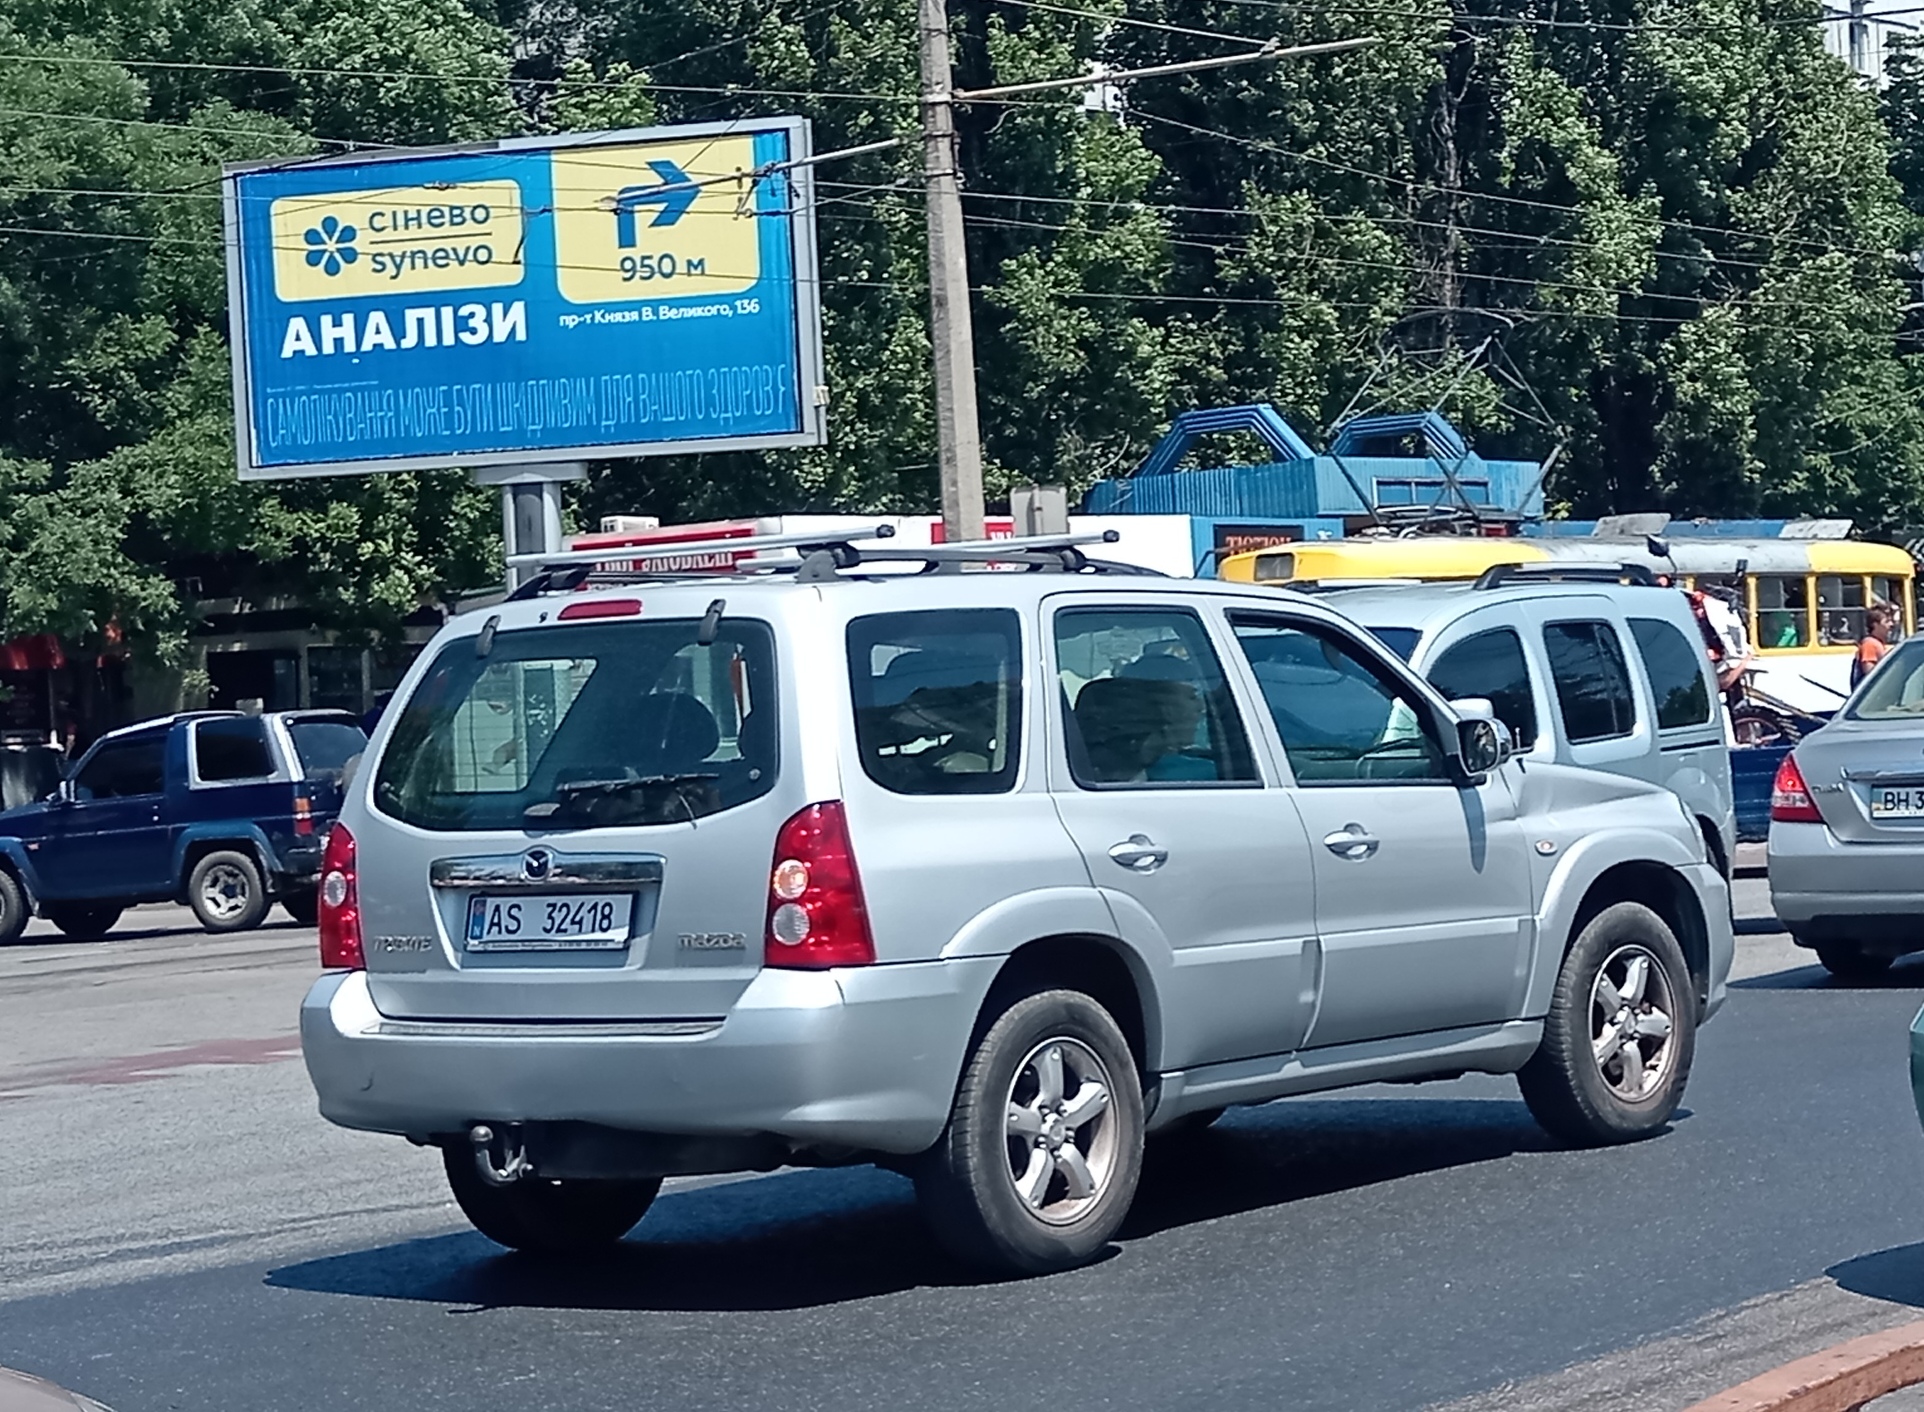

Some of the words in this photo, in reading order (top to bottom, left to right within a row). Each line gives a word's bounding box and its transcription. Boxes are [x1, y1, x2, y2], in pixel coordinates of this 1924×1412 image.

[371, 244, 493, 280] synevo
[620, 253, 676, 282] 950
[559, 313, 591, 329] пр-т
[594, 309, 640, 325] Князя
[642, 306, 657, 321] В.
[659, 303, 733, 319] Великого,
[735, 298, 760, 314] 136
[280, 301, 528, 359] АНАЛІЗИ
[267, 389, 396, 448] САМОЛІКУВАННЯ
[399, 386, 451, 438] МОЖЕ
[453, 383, 494, 435] БУТИ
[497, 376, 597, 438] ШКІДЛИВИМ
[601, 373, 633, 433] ДЛЯ
[639, 369, 705, 424] ВАШОГО
[1884, 791, 1910, 810] BH
[472, 926, 483, 937] N
[487, 903, 522, 936] AS
[542, 902, 614, 934] 32418
